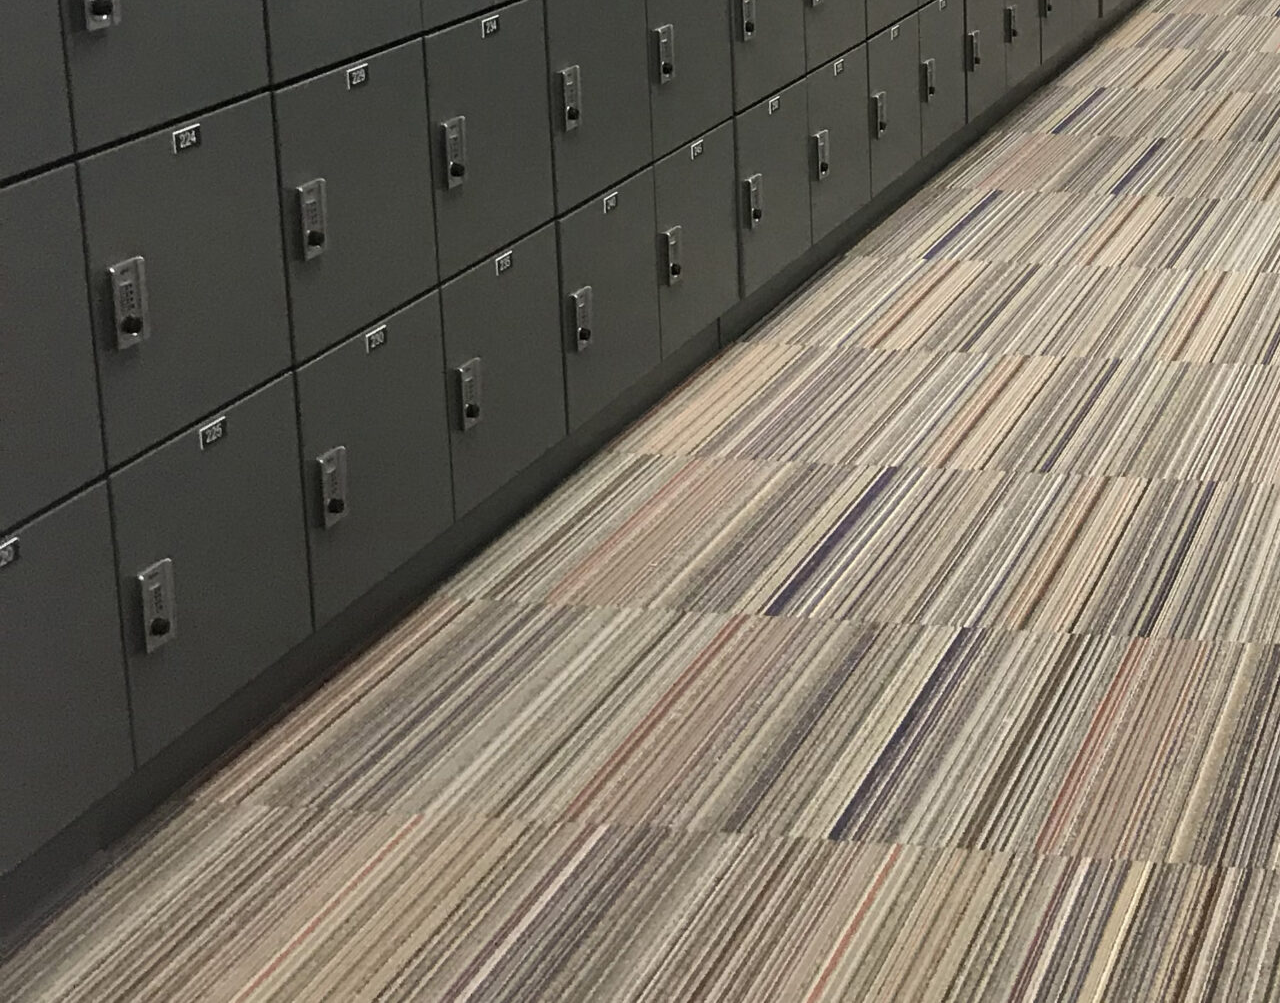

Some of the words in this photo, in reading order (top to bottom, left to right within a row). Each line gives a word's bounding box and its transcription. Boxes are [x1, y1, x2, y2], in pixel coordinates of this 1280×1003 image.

[486, 19, 497, 34] 234
[352, 69, 365, 85] 229
[179, 129, 196, 148] 224
[499, 256, 511, 271] 235
[370, 331, 384, 348] 230
[205, 422, 223, 443] 225
